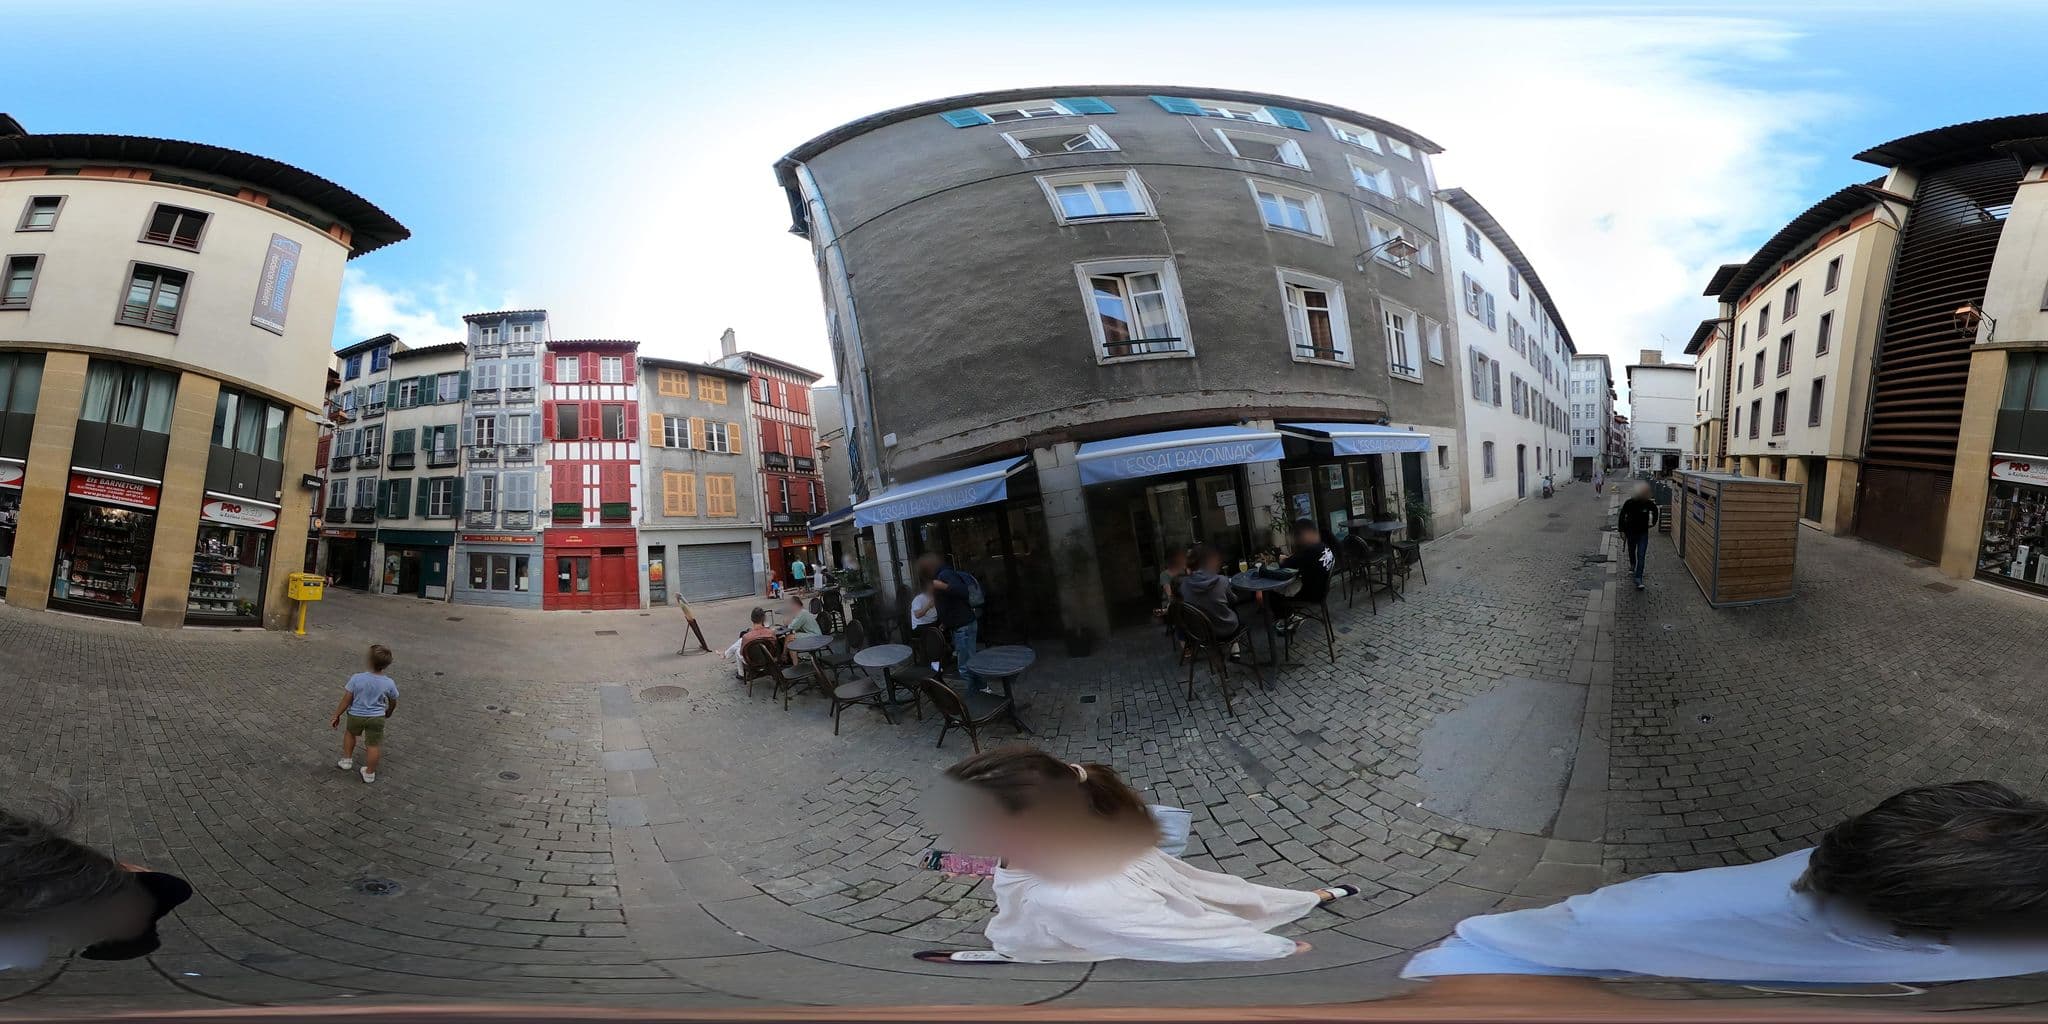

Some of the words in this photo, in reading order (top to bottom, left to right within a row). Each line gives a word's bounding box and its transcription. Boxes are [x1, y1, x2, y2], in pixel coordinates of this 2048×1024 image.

[1114, 454, 1171, 476] L'ESSAI
[1175, 444, 1256, 467] BAYONNAIS
[99, 478, 144, 492] BARNETCHE
[873, 503, 908, 522] L'ESSAI
[909, 488, 976, 515] BAYONNAIS
